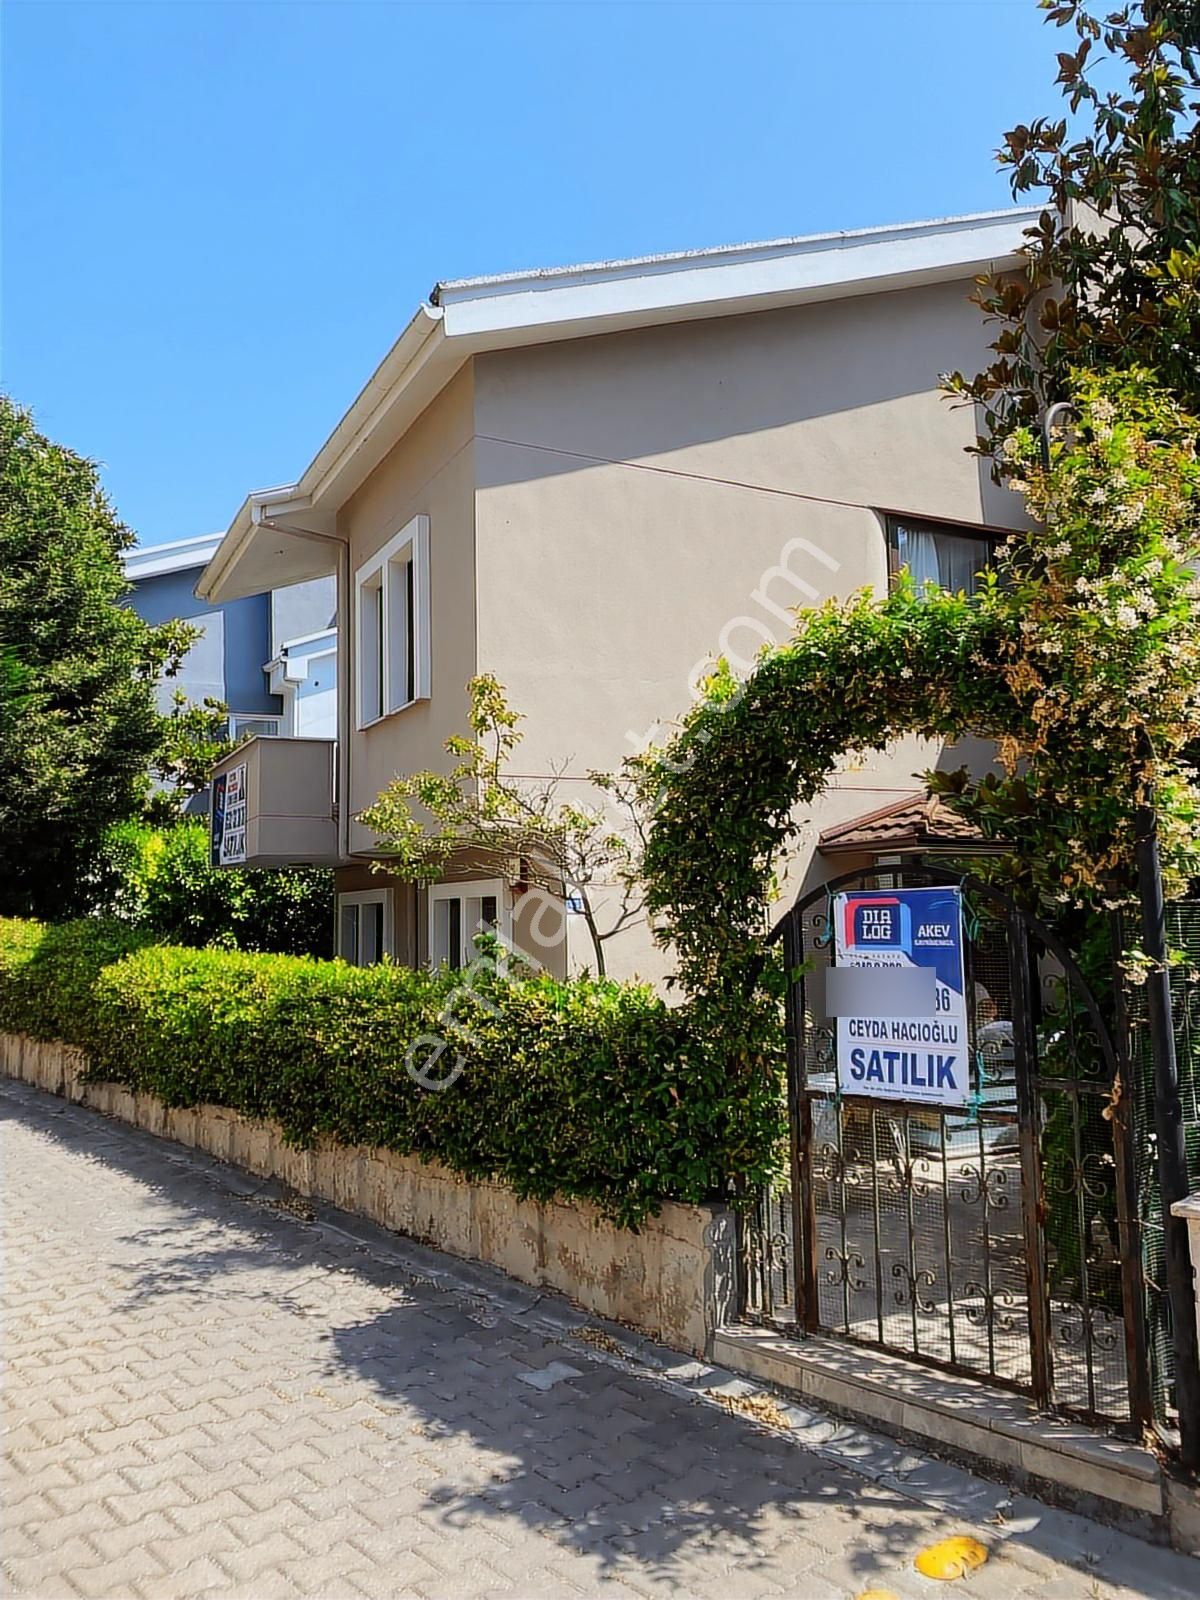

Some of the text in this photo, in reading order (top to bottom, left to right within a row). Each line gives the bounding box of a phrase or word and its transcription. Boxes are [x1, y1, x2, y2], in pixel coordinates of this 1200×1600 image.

[862, 910, 892, 924] DIA
[862, 925, 892, 939] LOG
[917, 925, 950, 937] AKEV
[849, 1019, 958, 1043] CEYDA HACIOĞLU
[850, 1048, 957, 1089] SATILIK
